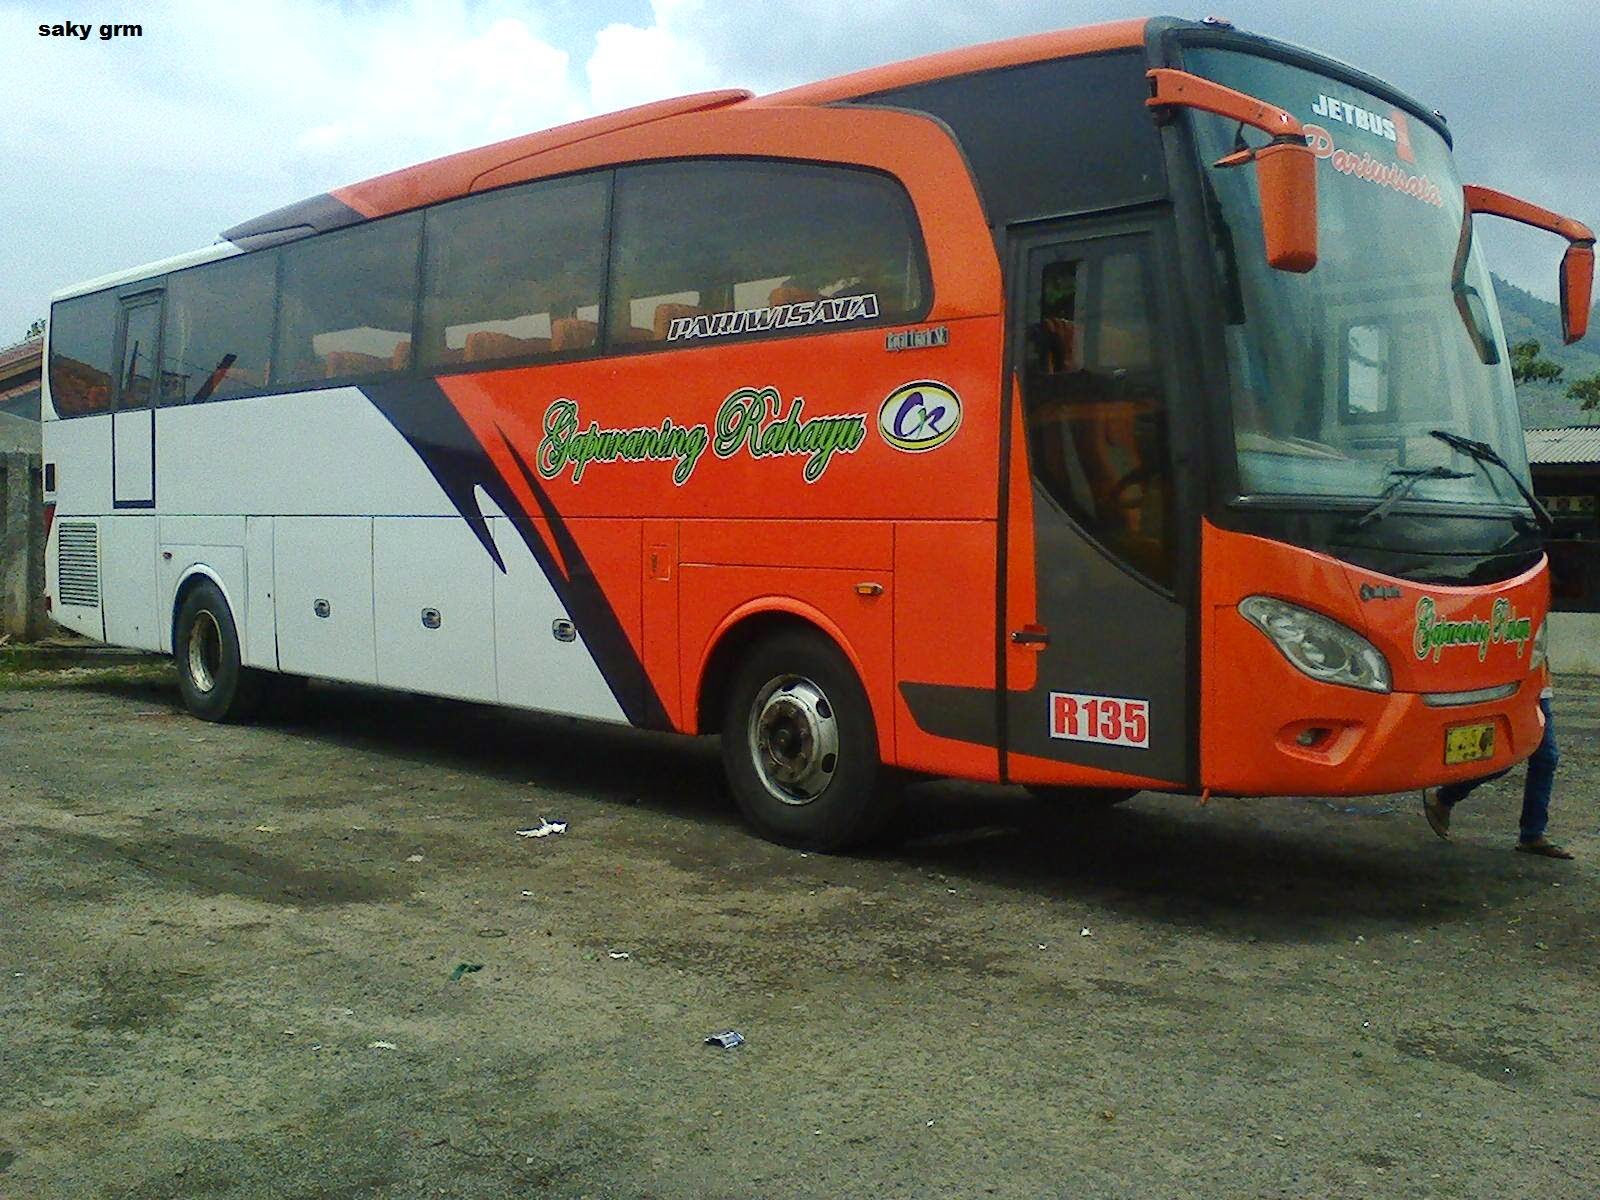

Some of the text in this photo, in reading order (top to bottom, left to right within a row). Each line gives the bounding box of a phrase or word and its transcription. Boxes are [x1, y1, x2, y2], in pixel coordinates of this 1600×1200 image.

[1311, 94, 1397, 142] JETBUS
[1302, 123, 1443, 208] Pariwisata
[666, 293, 880, 341] PARIWISATA
[536, 386, 868, 487] Gapuraning Rahayu
